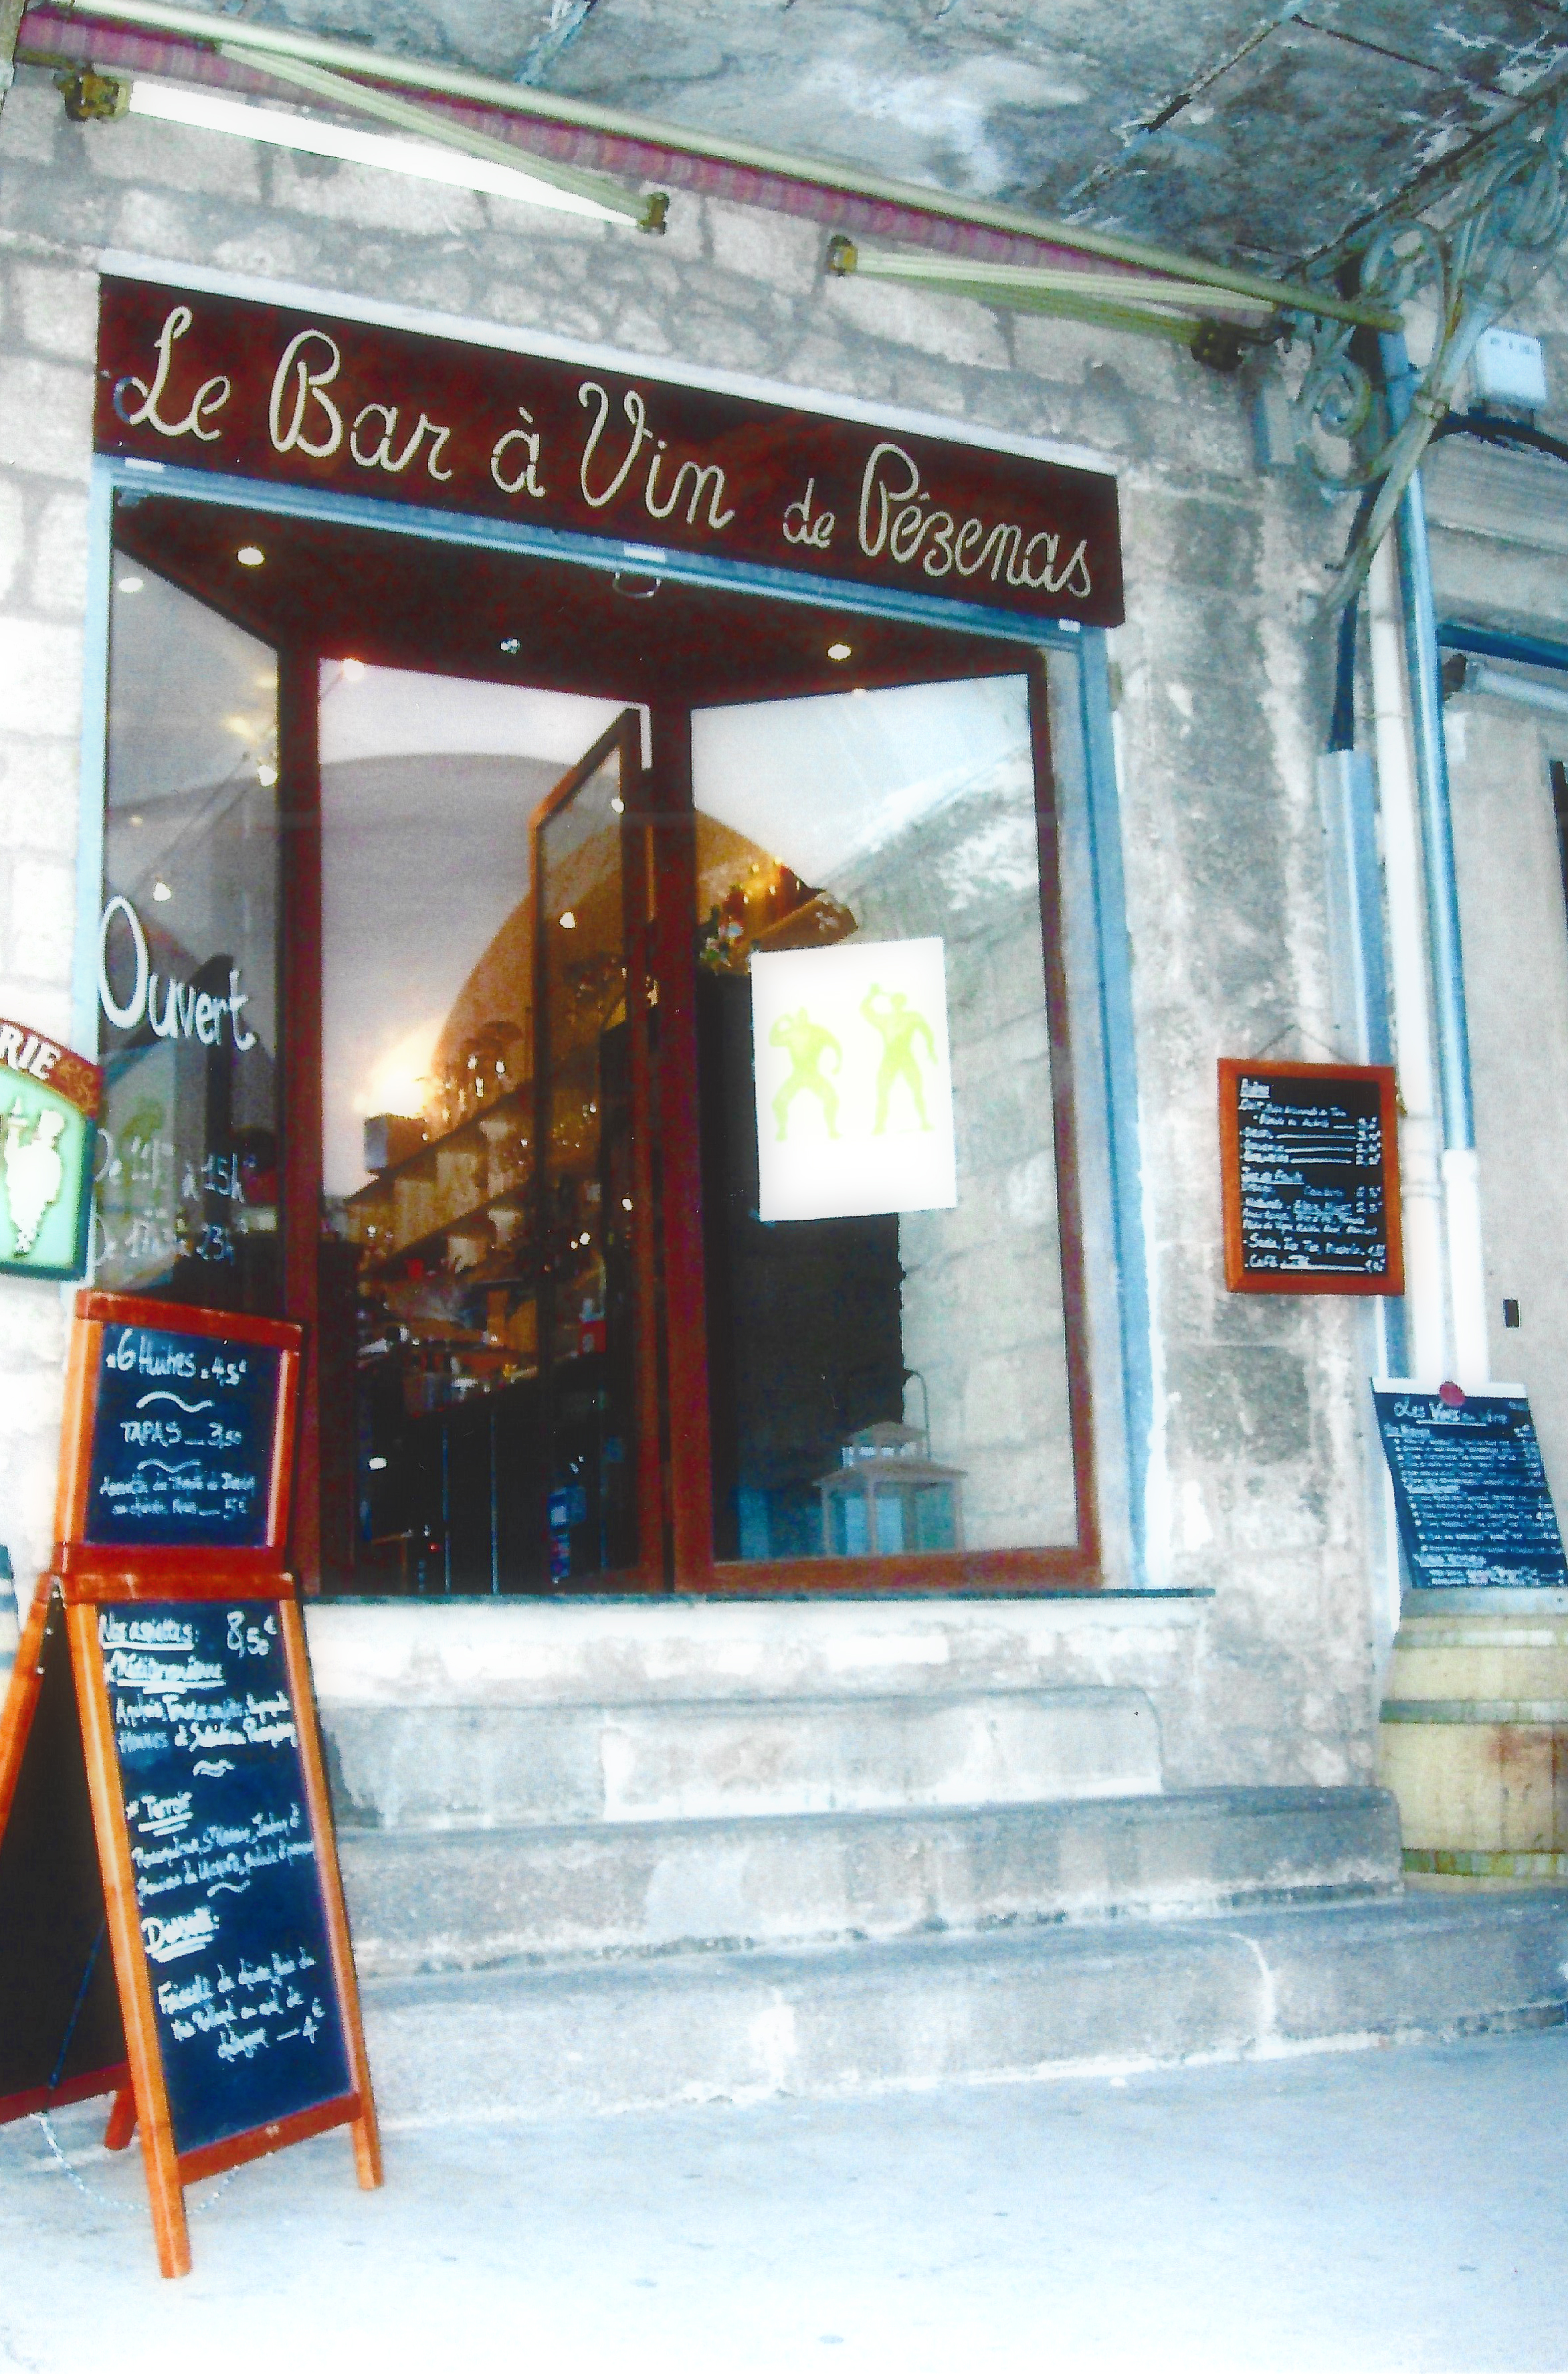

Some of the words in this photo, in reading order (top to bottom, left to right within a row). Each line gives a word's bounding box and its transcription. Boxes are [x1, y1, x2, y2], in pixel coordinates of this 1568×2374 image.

[113, 305, 231, 442] Le
[269, 329, 453, 481] Bar
[491, 407, 546, 497] à
[578, 379, 735, 530] Vin
[783, 478, 835, 549] de
[857, 442, 1092, 598] Pézenas
[101, 895, 258, 1051] Ouvert
[120, 1420, 182, 1447] TAPAS
